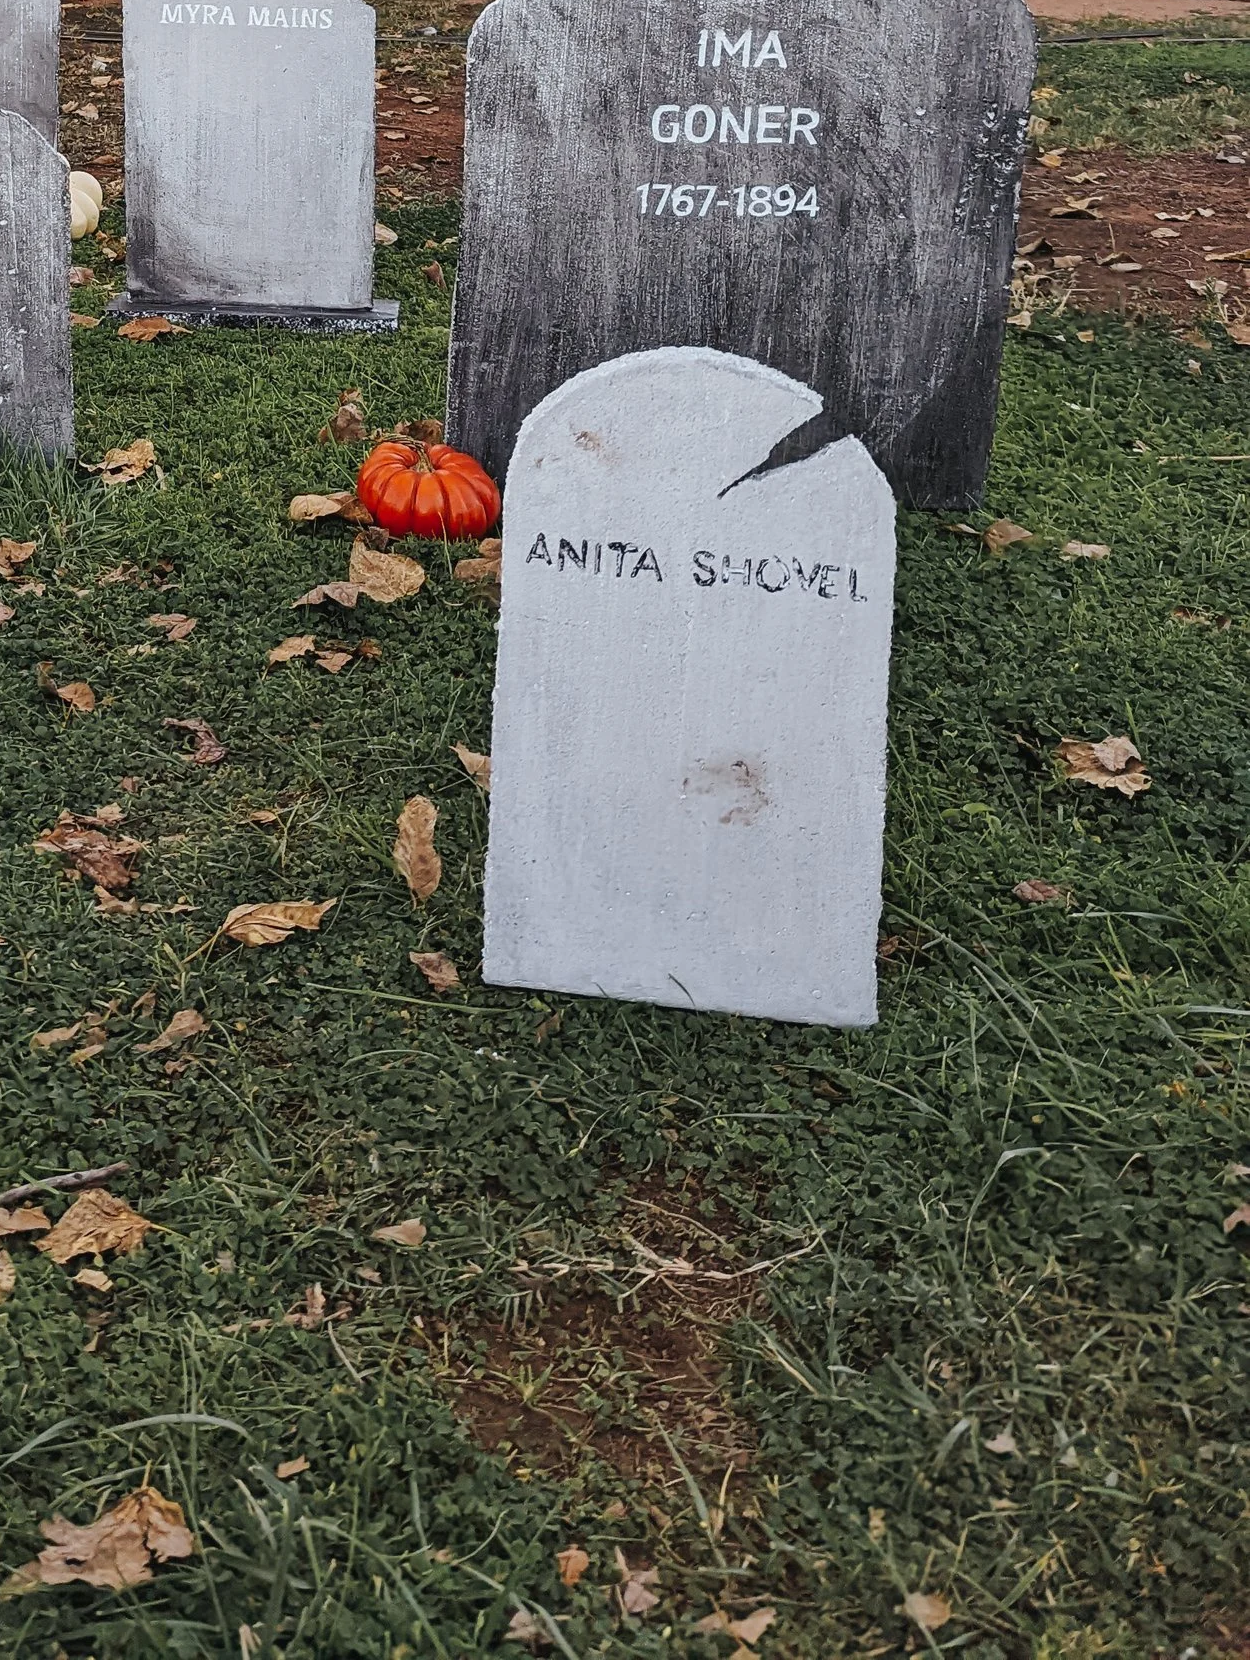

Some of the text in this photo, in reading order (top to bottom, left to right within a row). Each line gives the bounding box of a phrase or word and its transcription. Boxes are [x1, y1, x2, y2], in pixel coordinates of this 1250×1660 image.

[159, 3, 334, 30] MYRA MAINS
[698, 27, 788, 69] IMA
[651, 103, 820, 145] GONER
[636, 183, 820, 218] 1767-1894
[526, 532, 868, 603] ANITA SHOVEL
